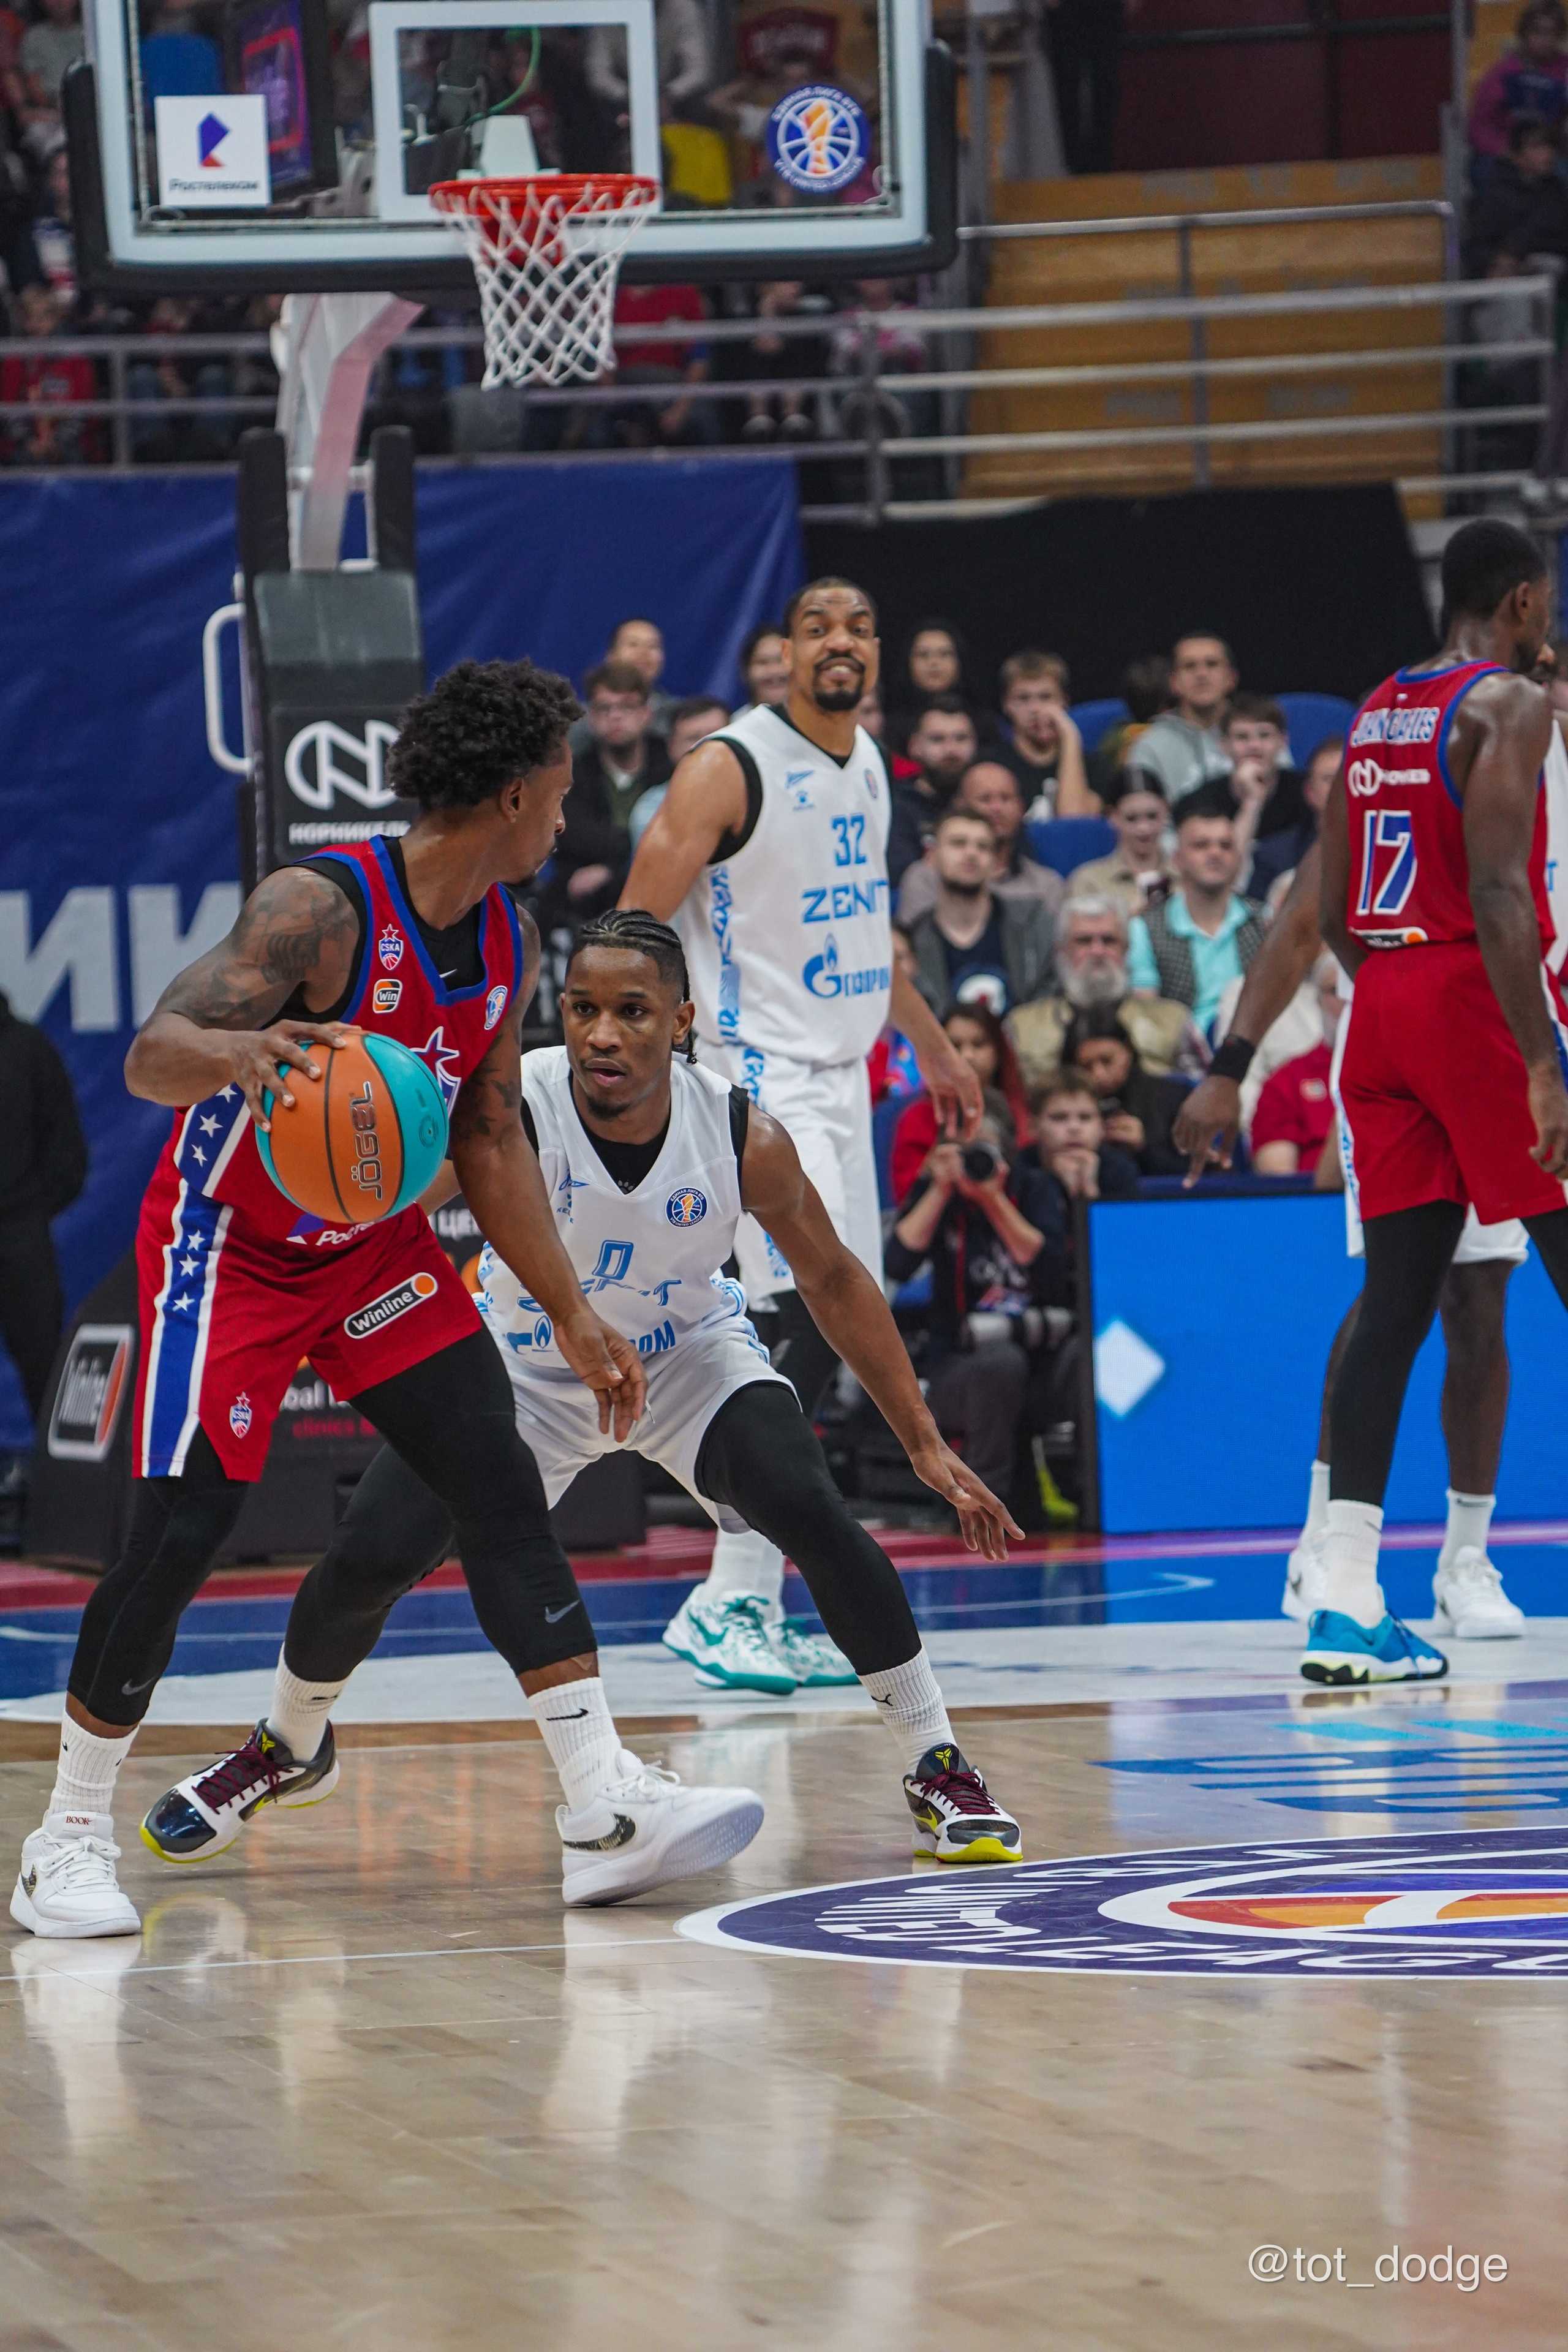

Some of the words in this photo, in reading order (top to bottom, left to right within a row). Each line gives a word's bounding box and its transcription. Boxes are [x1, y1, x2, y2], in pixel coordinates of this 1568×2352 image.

[831, 812, 867, 867] 32
[1355, 809, 1418, 915] 17
[379, 990, 398, 1001] Win
[350, 1080, 383, 1200] JÖGEL
[670, 1189, 687, 1202] ЕДИНАЯ
[689, 1215, 703, 1225] LEAGUE
[352, 1291, 413, 1332] Winline
[66, 1816, 89, 1825] BOOK
[813, 1880, 1102, 1942] UNITED
